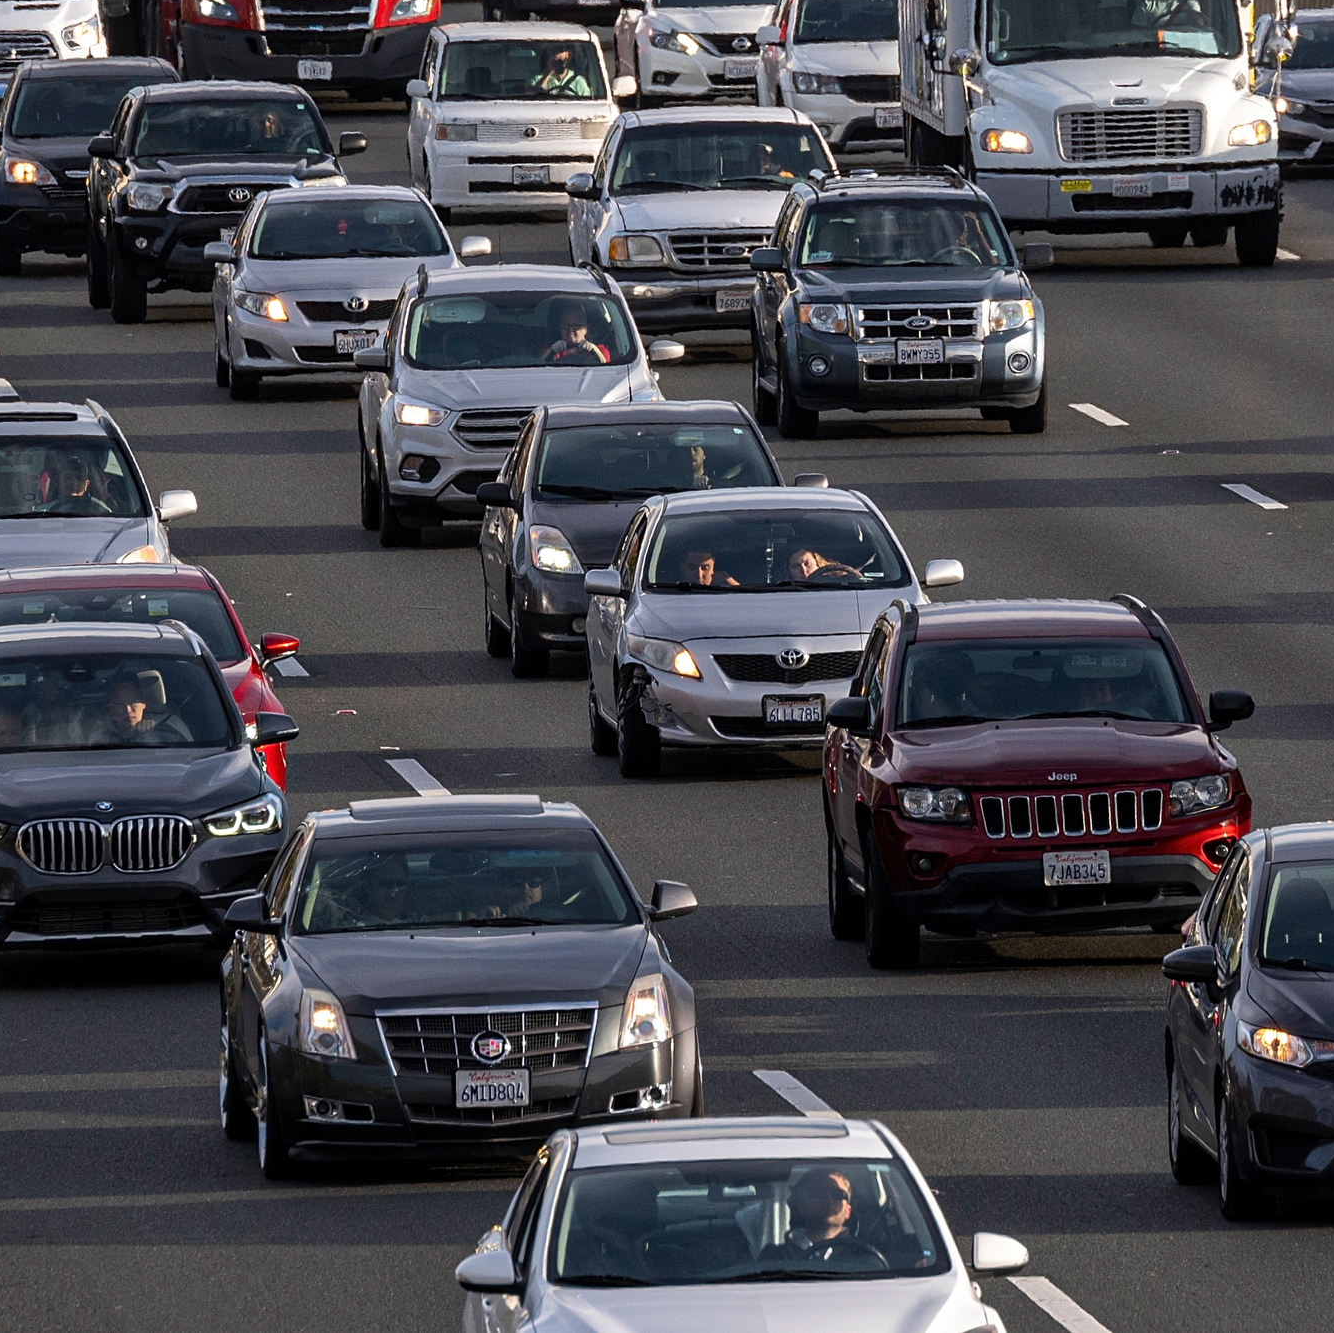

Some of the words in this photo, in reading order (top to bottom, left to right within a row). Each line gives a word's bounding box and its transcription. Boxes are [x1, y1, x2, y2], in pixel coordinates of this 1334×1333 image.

[1048, 772, 1077, 782] Jeep
[1056, 854, 1099, 864] California
[1047, 863, 1106, 881] 7JAB345
[470, 1071, 517, 1083] California
[461, 1082, 524, 1103] 6MID804
